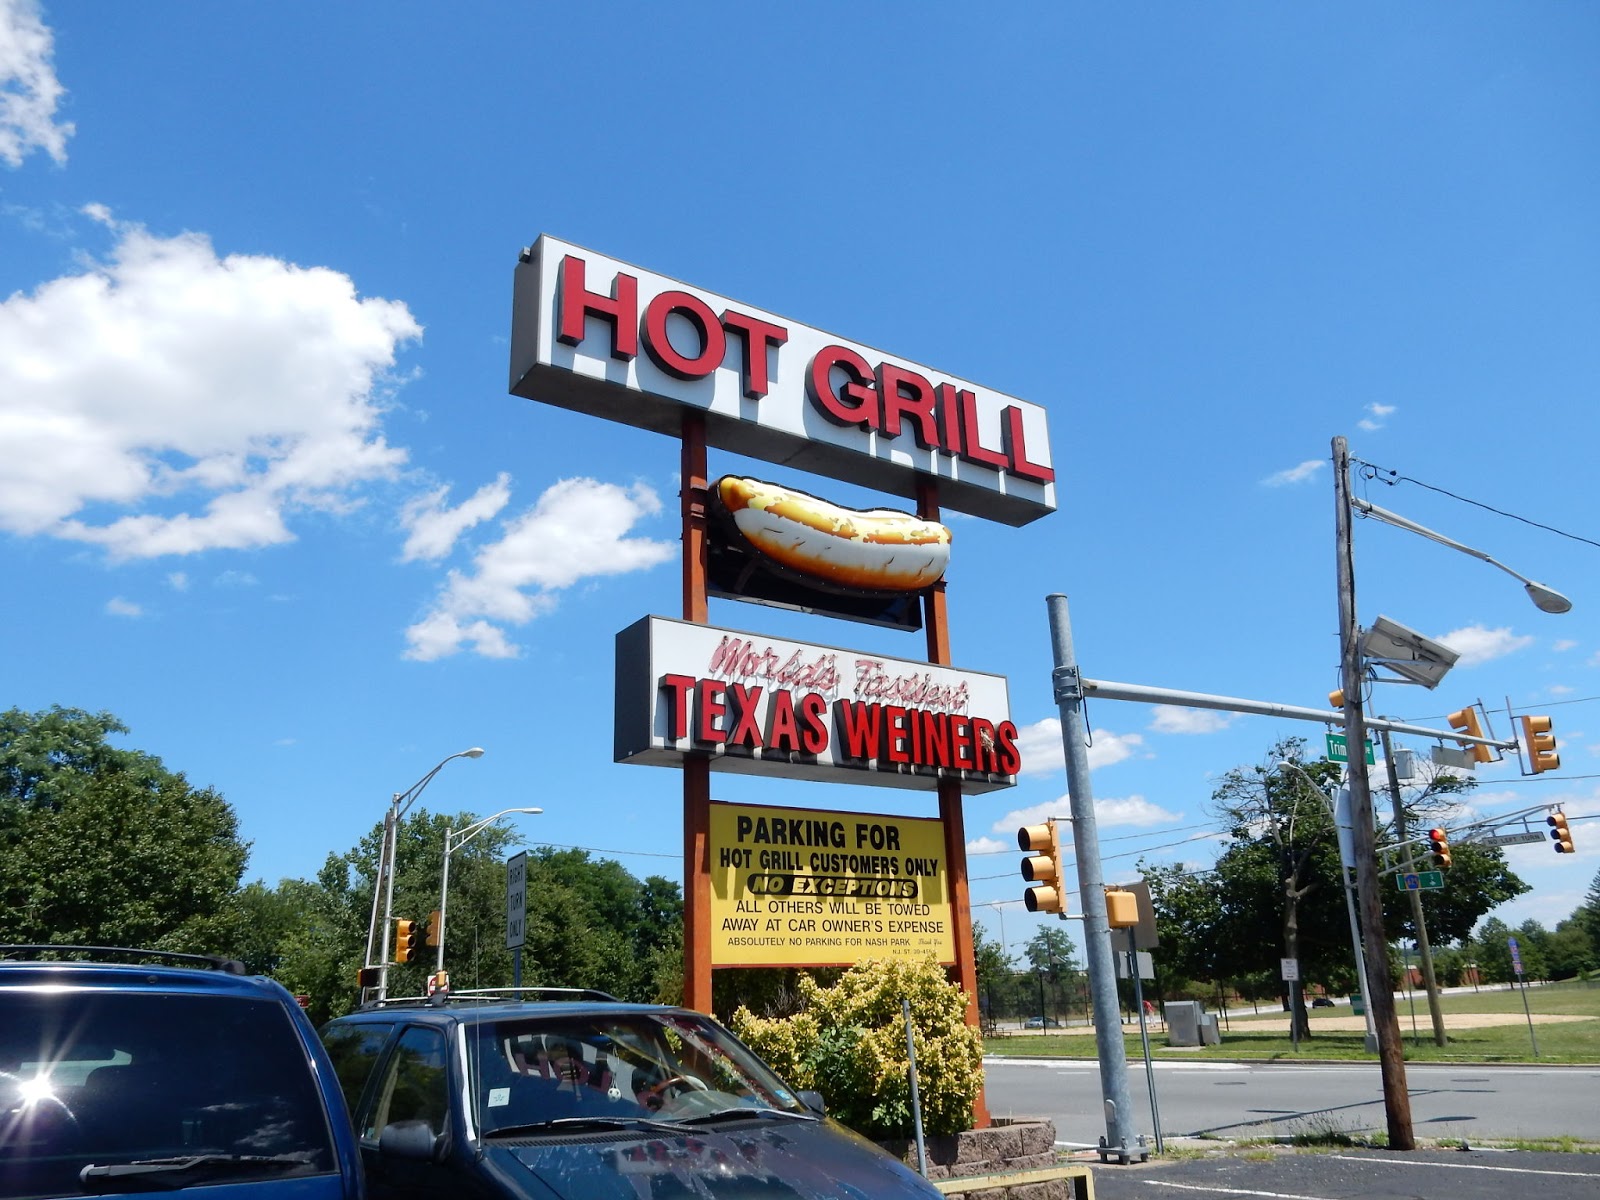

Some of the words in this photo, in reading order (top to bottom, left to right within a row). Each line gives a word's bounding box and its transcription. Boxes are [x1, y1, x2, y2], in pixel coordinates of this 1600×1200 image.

[557, 255, 788, 400] HOT
[805, 345, 1055, 484] GRILL
[853, 660, 970, 709] Tastiest
[659, 674, 829, 755] TEXAS
[833, 698, 1022, 776] WEINERS
[737, 815, 846, 848] PARKING
[856, 823, 901, 851] FOR
[1521, 833, 1540, 841] TURN
[720, 847, 752, 869] HOT
[759, 850, 804, 871] GRILL
[809, 852, 899, 875] CUSTOMERS
[905, 858, 938, 876] ONLY
[509, 863, 524, 886] RIGHT
[752, 876, 785, 893] NO
[792, 877, 915, 897] EXCEPTIONS
[510, 890, 523, 911] TURN
[736, 900, 762, 913] ALL
[768, 900, 823, 914] OTHERS
[829, 902, 860, 915] WILL
[865, 903, 882, 915] BE
[887, 903, 930, 916] TOWED
[722, 918, 759, 931] AWAY
[765, 919, 782, 931] AT
[788, 919, 816, 932] CAR
[822, 919, 883, 933] OWNER'S
[888, 921, 944, 933] EXPENSE
[728, 937, 785, 946] ABSOLUTELY
[789, 937, 802, 946] NO
[805, 937, 842, 946] PARKING
[845, 938, 862, 946] FOR
[865, 938, 888, 946] NASH
[890, 938, 911, 946] PARK
